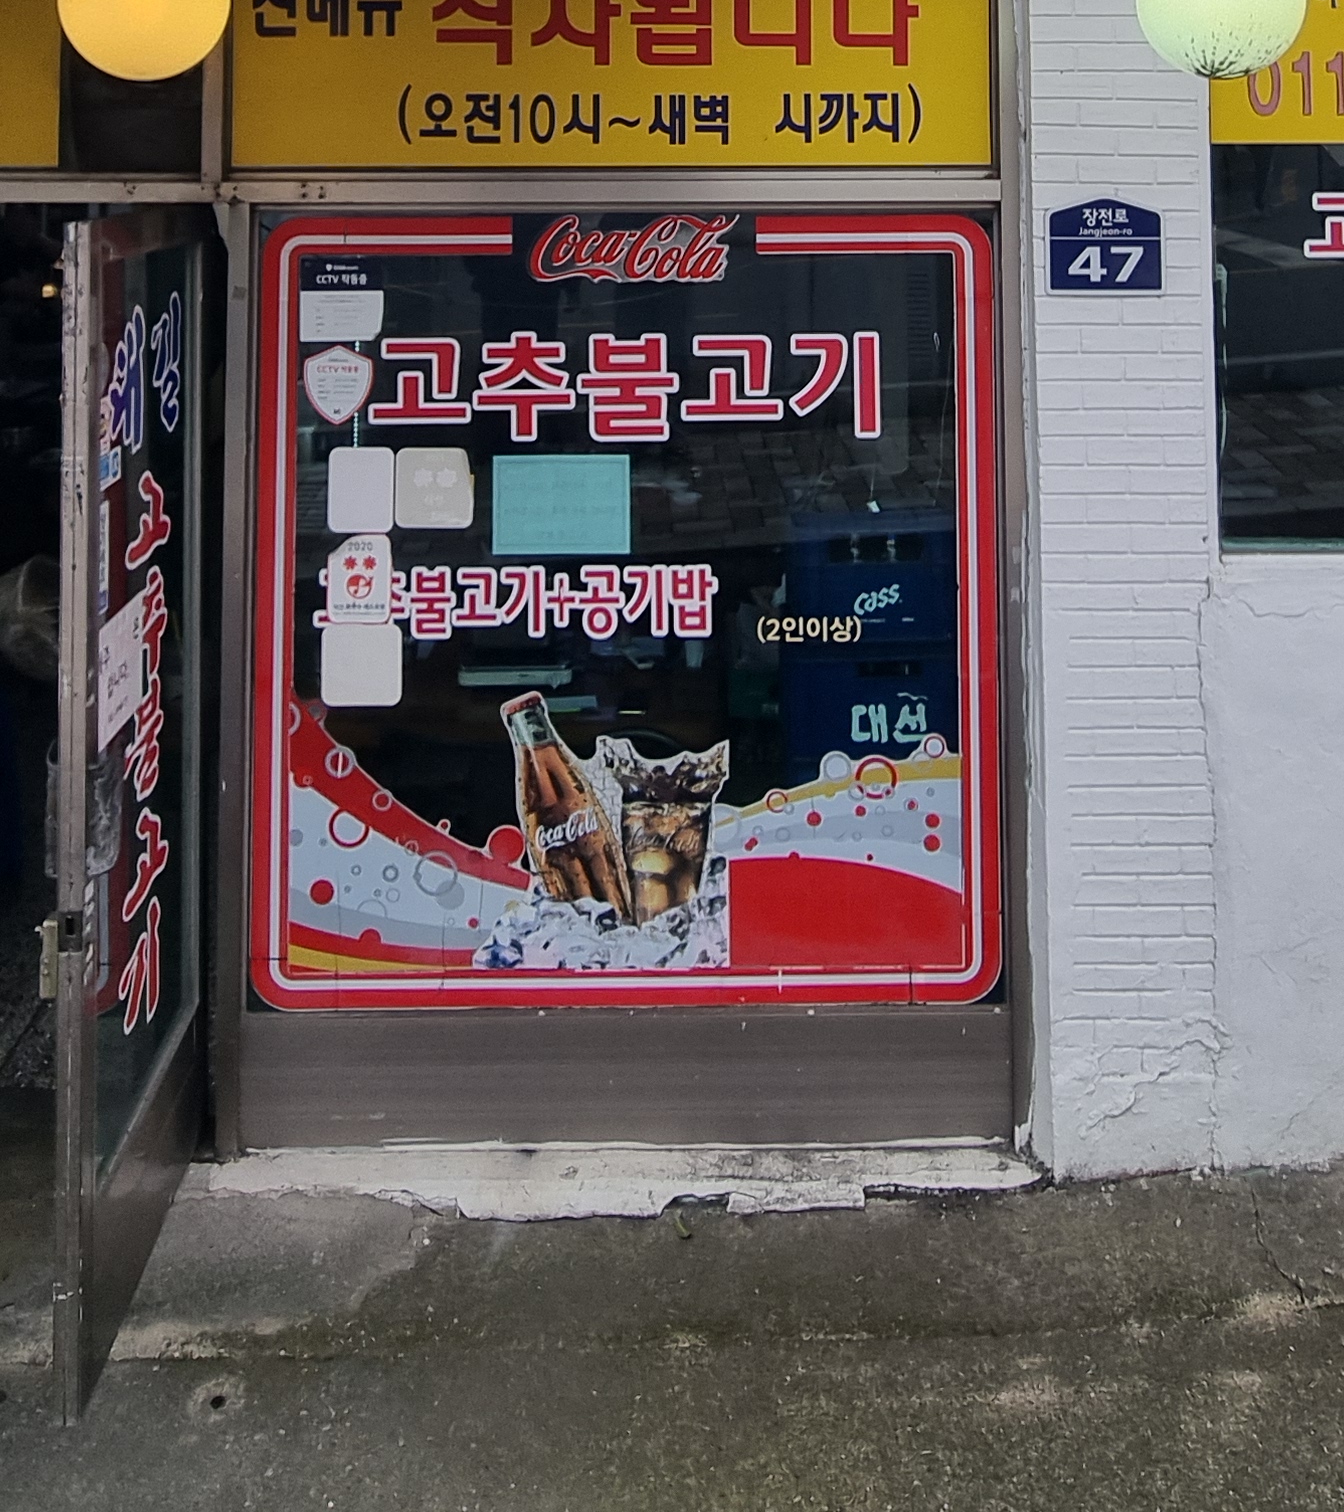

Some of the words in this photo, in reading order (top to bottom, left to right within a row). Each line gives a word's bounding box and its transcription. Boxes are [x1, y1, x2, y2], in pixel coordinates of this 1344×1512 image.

[1082, 208, 1130, 227] 장전로
[1078, 227, 1133, 238] Jangjeon-ro
[1067, 245, 1145, 283] 47
[315, 274, 340, 286] CCTV
[367, 330, 882, 443] 고추불고기
[347, 541, 374, 553] 2020
[756, 615, 862, 644] (2인이상)
[121, 469, 172, 1036] 고추불고기
